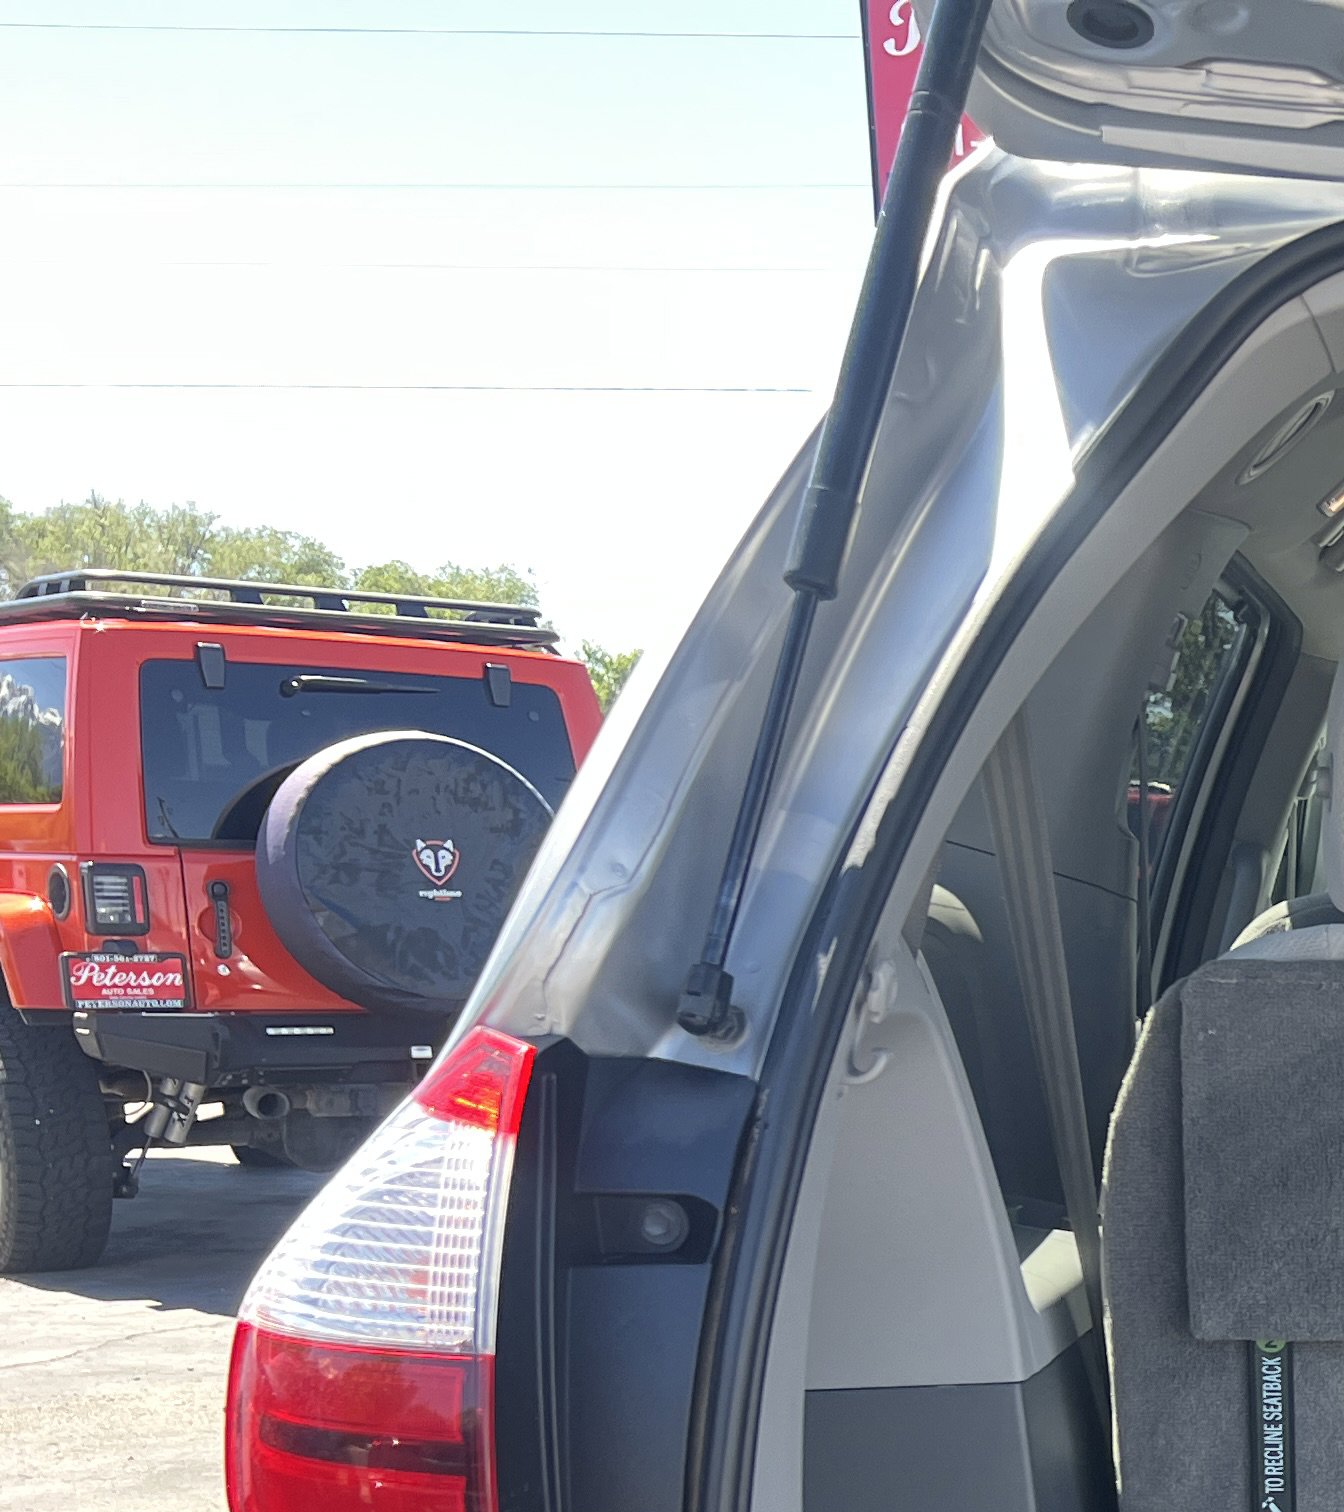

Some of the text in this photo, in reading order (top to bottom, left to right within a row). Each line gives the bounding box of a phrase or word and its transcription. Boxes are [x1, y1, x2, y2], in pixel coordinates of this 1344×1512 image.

[70, 961, 183, 986] Peterson
[101, 987, 125, 995] AUTO
[1261, 1356, 1283, 1421] SEATBACK
[1264, 1423, 1284, 1476] RECLINE
[1264, 1478, 1285, 1494] TO
